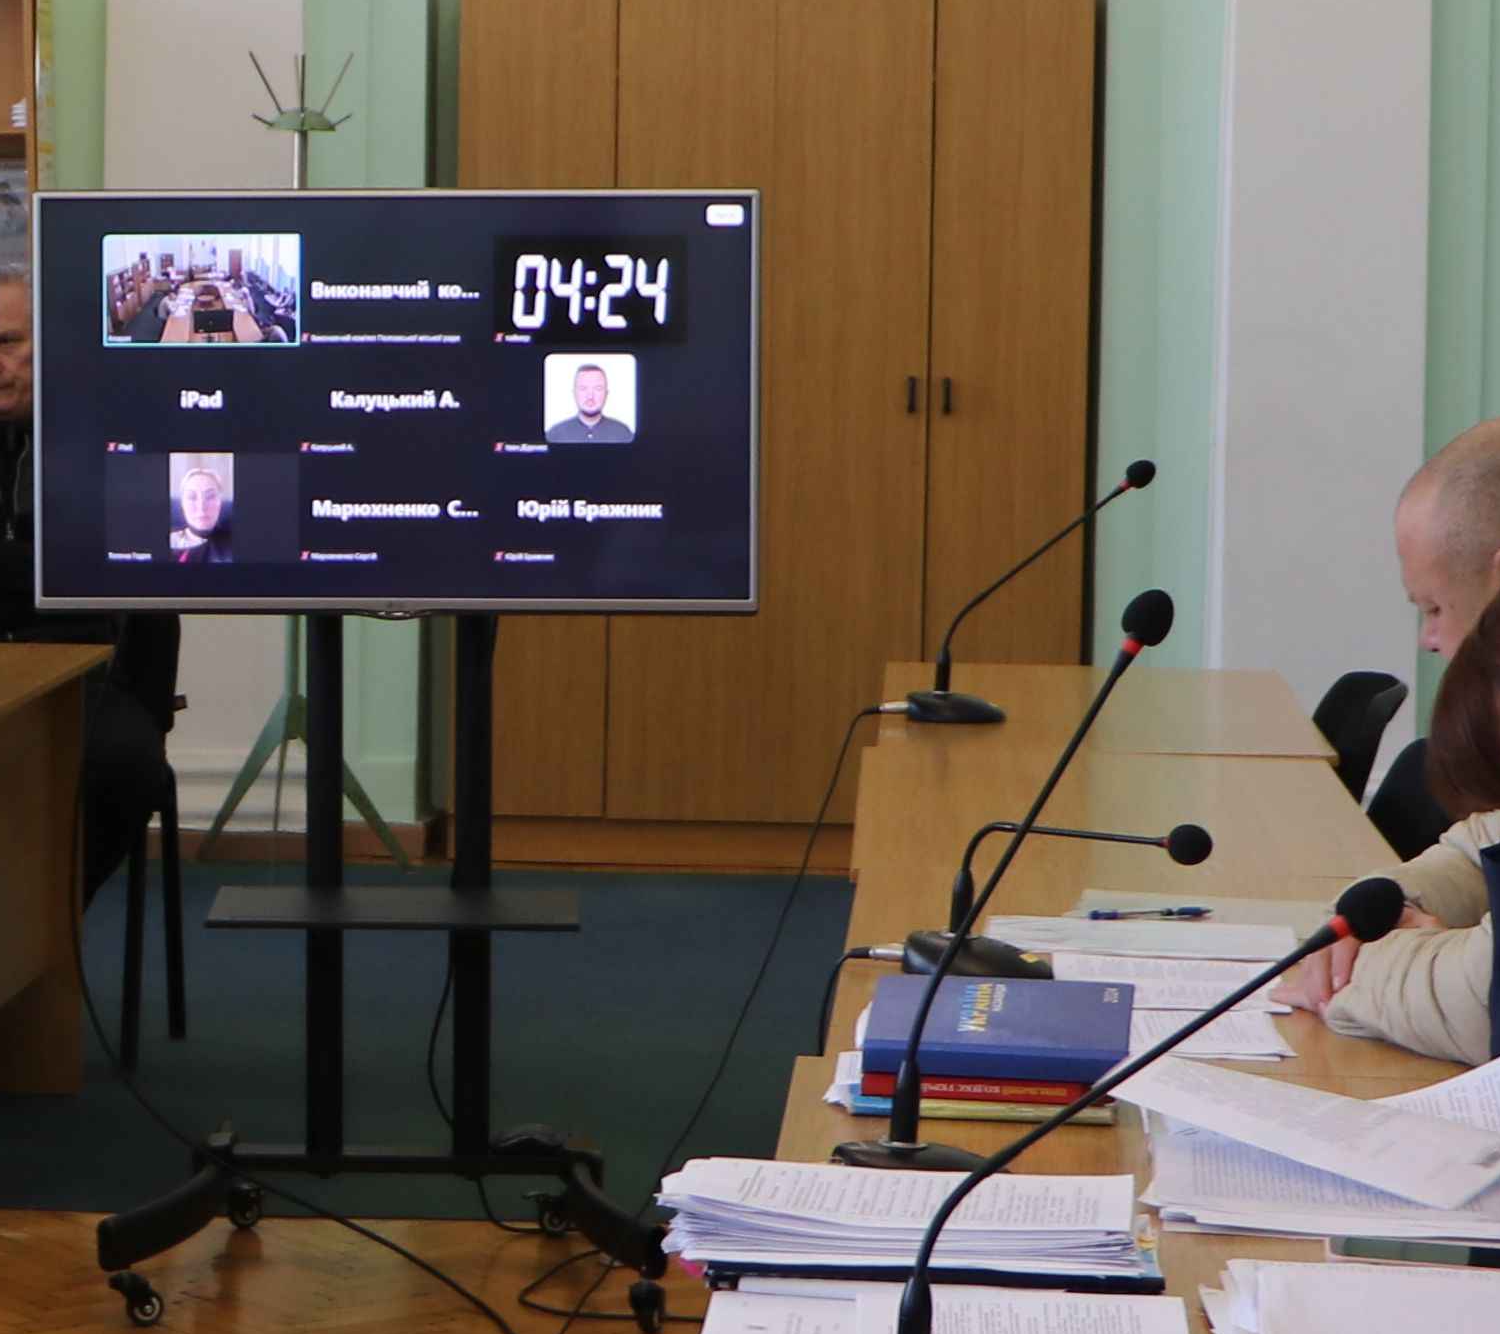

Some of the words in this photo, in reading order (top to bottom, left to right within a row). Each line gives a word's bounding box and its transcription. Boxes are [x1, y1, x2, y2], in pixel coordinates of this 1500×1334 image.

[311, 280, 430, 300] Виконавчий
[512, 254, 669, 329] 04:24
[180, 390, 223, 409] iPad
[330, 390, 436, 413] Калуцький
[438, 390, 460, 409] А.
[312, 499, 441, 522] Марюхненко
[517, 499, 570, 523] Юрій
[573, 500, 663, 523] Бражник
